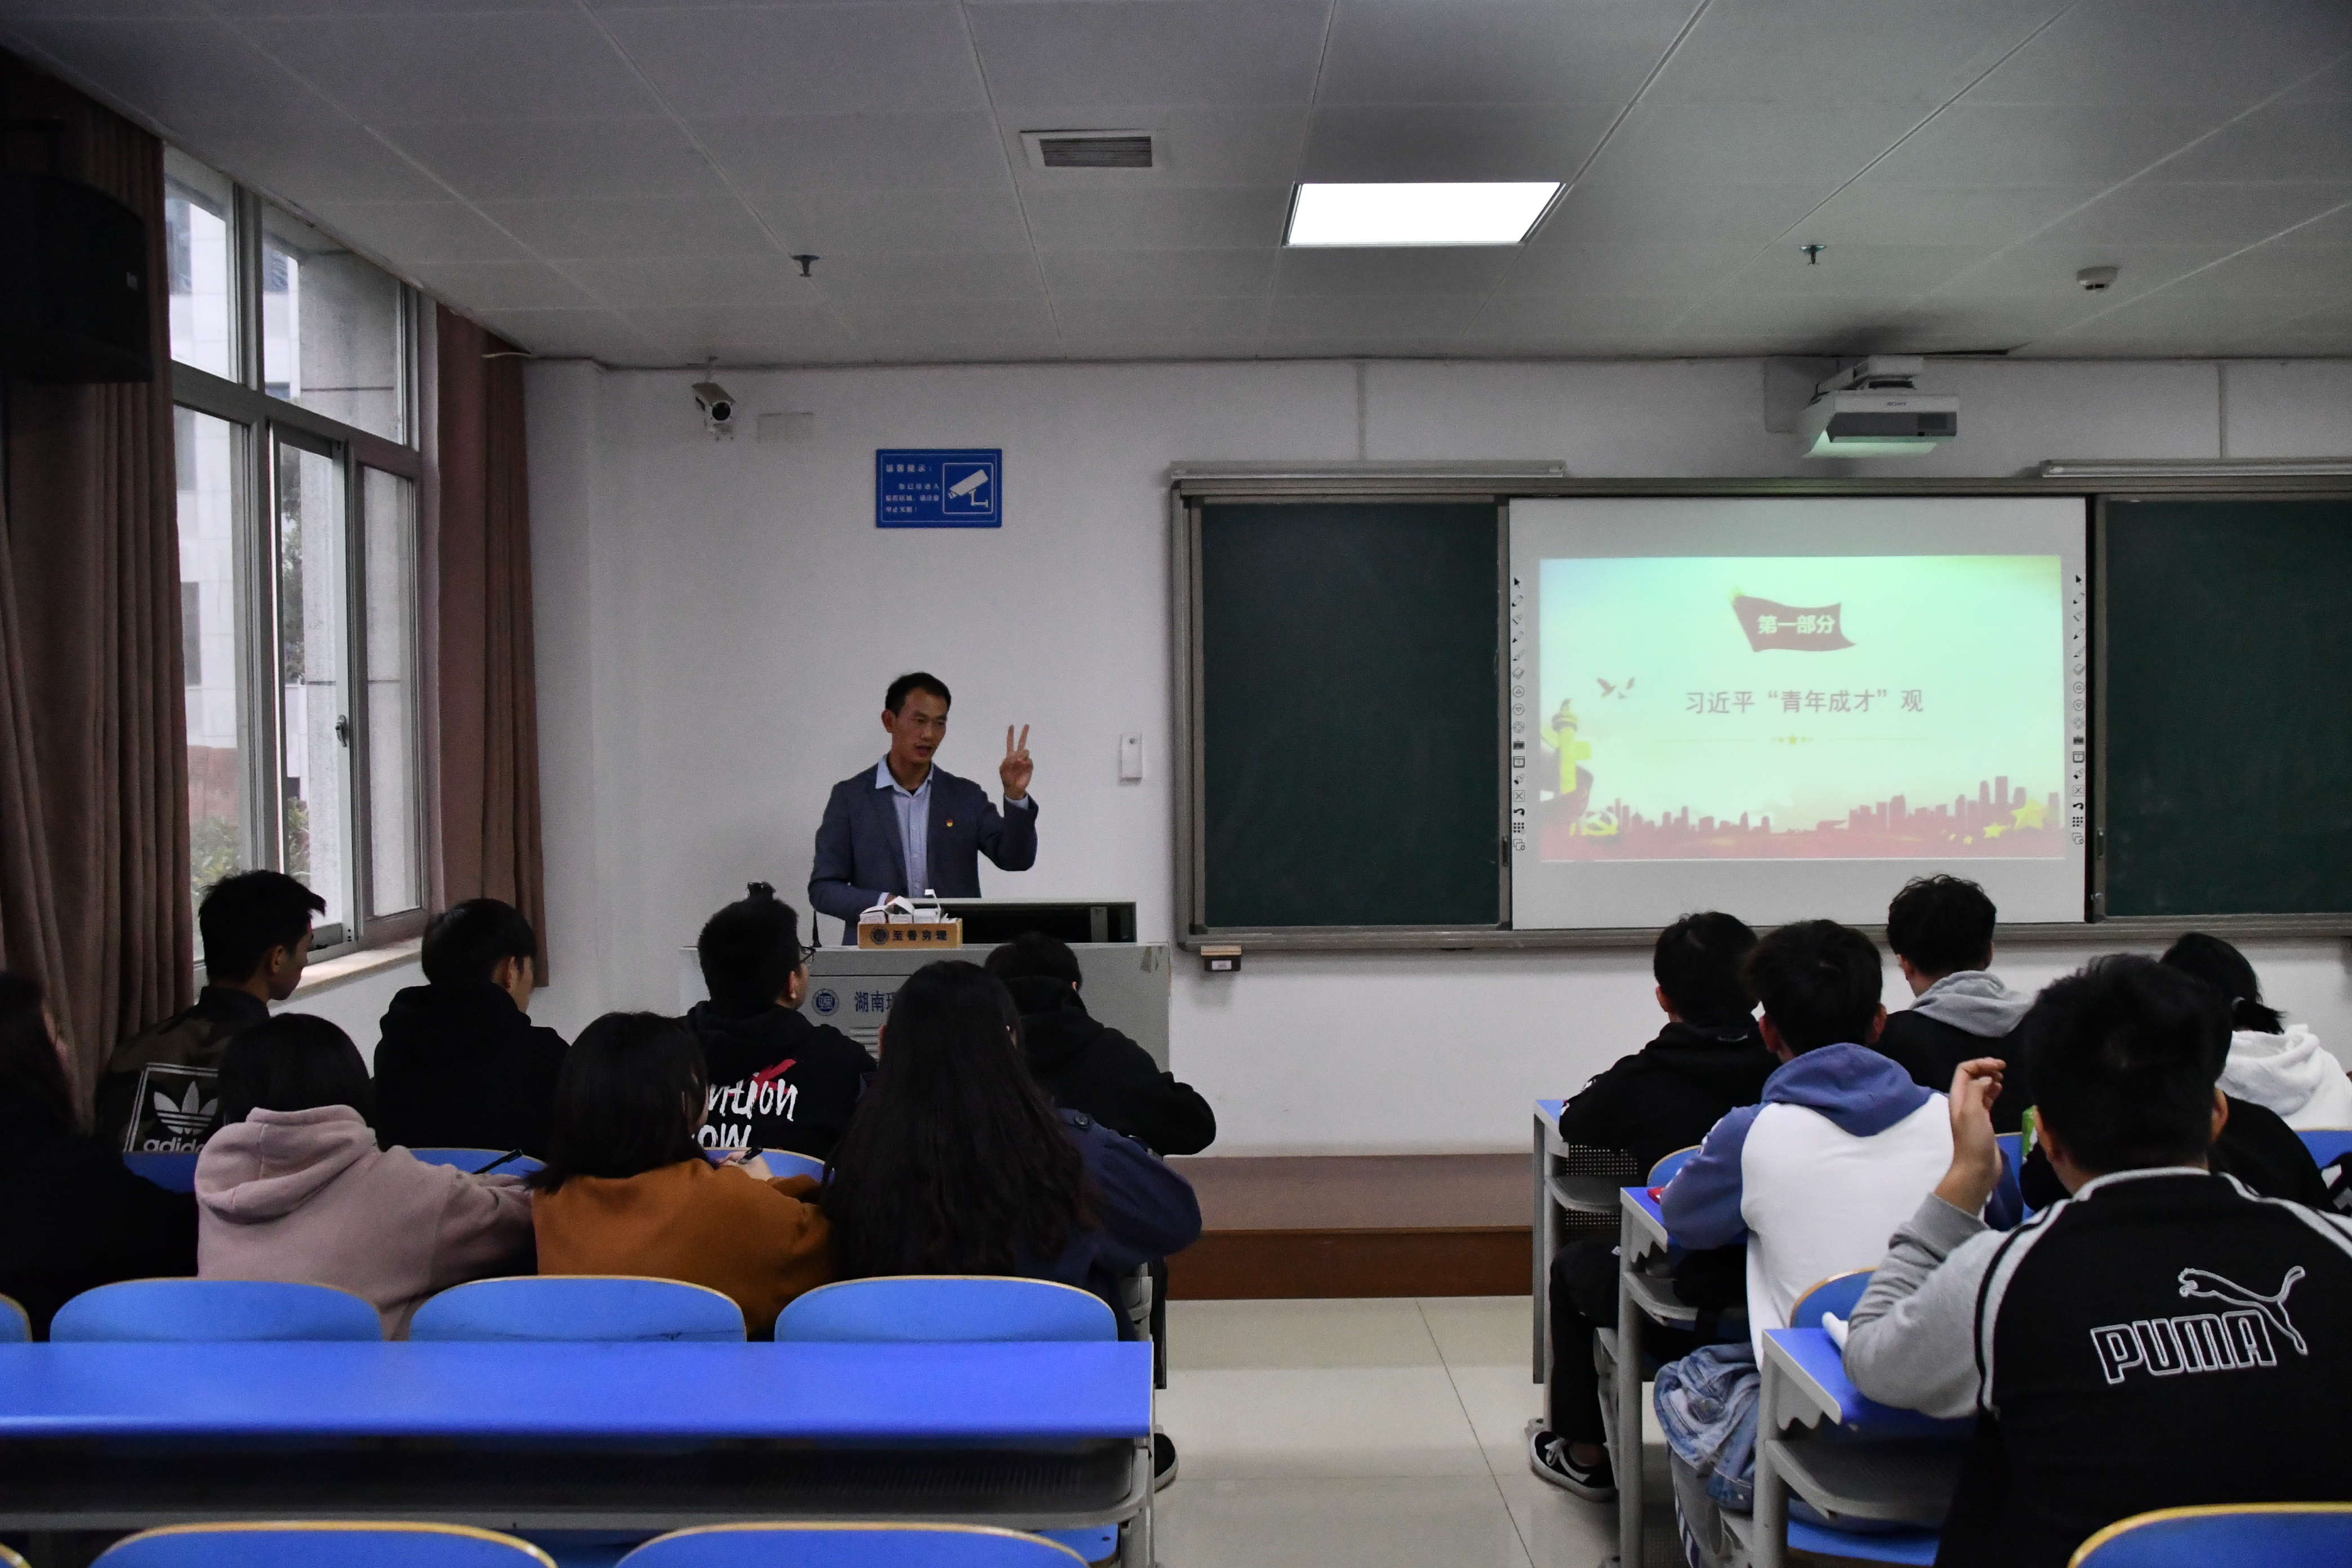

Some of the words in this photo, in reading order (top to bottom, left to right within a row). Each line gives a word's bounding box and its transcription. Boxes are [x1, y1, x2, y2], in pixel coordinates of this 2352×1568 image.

[1758, 614, 1836, 635] 第一部分
[2090, 1309, 2278, 1384] PUMA
